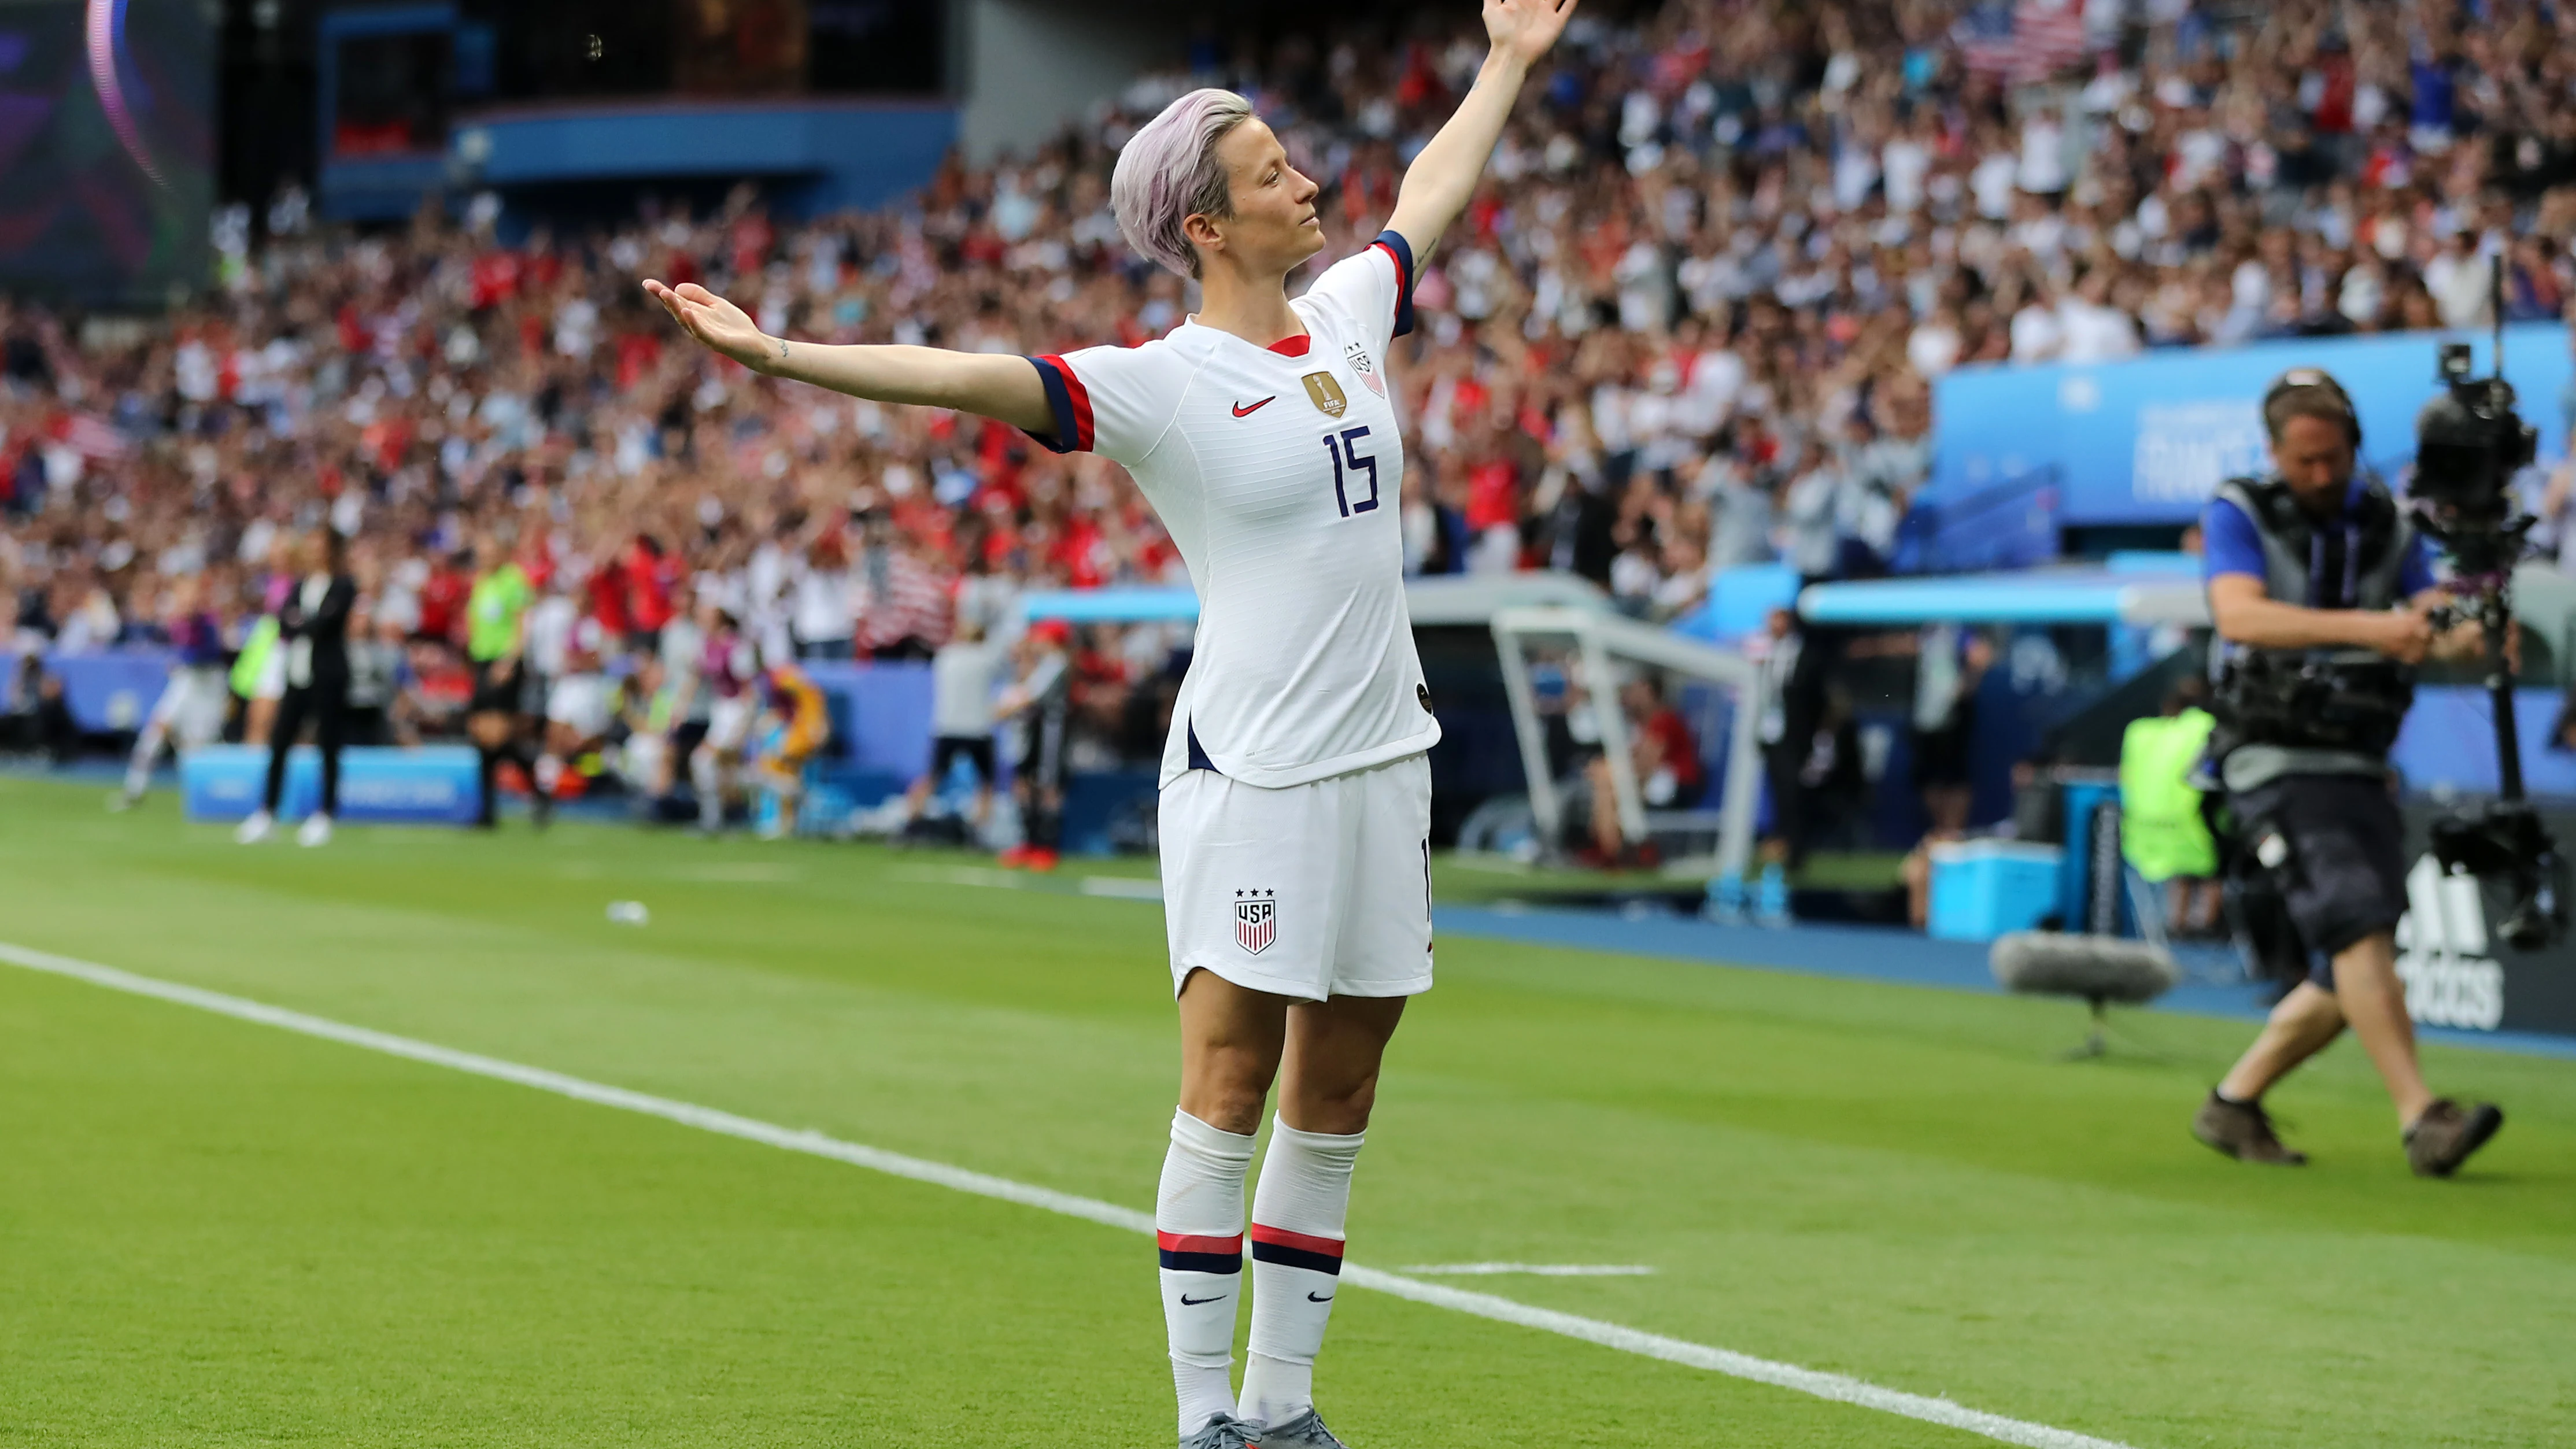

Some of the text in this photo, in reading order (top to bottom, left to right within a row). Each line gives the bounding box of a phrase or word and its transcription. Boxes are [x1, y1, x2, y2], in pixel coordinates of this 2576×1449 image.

[1323, 399, 1340, 408] FIFA
[1323, 426, 1378, 518] 15
[1239, 904, 1272, 923] USA
